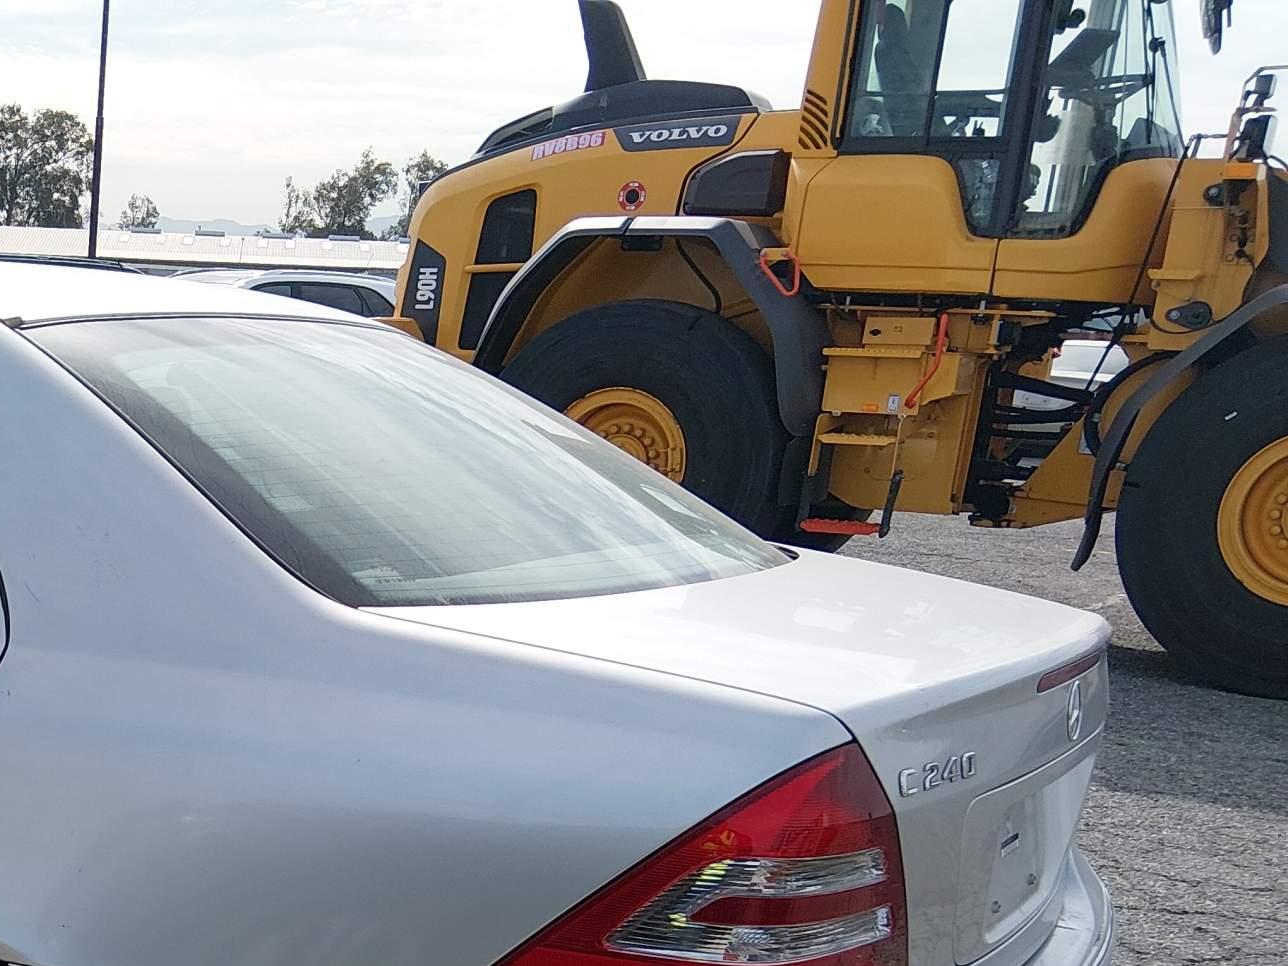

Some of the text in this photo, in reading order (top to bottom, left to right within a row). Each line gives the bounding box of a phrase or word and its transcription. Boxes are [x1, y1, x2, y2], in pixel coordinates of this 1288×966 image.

[629, 125, 728, 143] VOLVO
[415, 267, 439, 310] L90H
[898, 751, 976, 797] C 240
